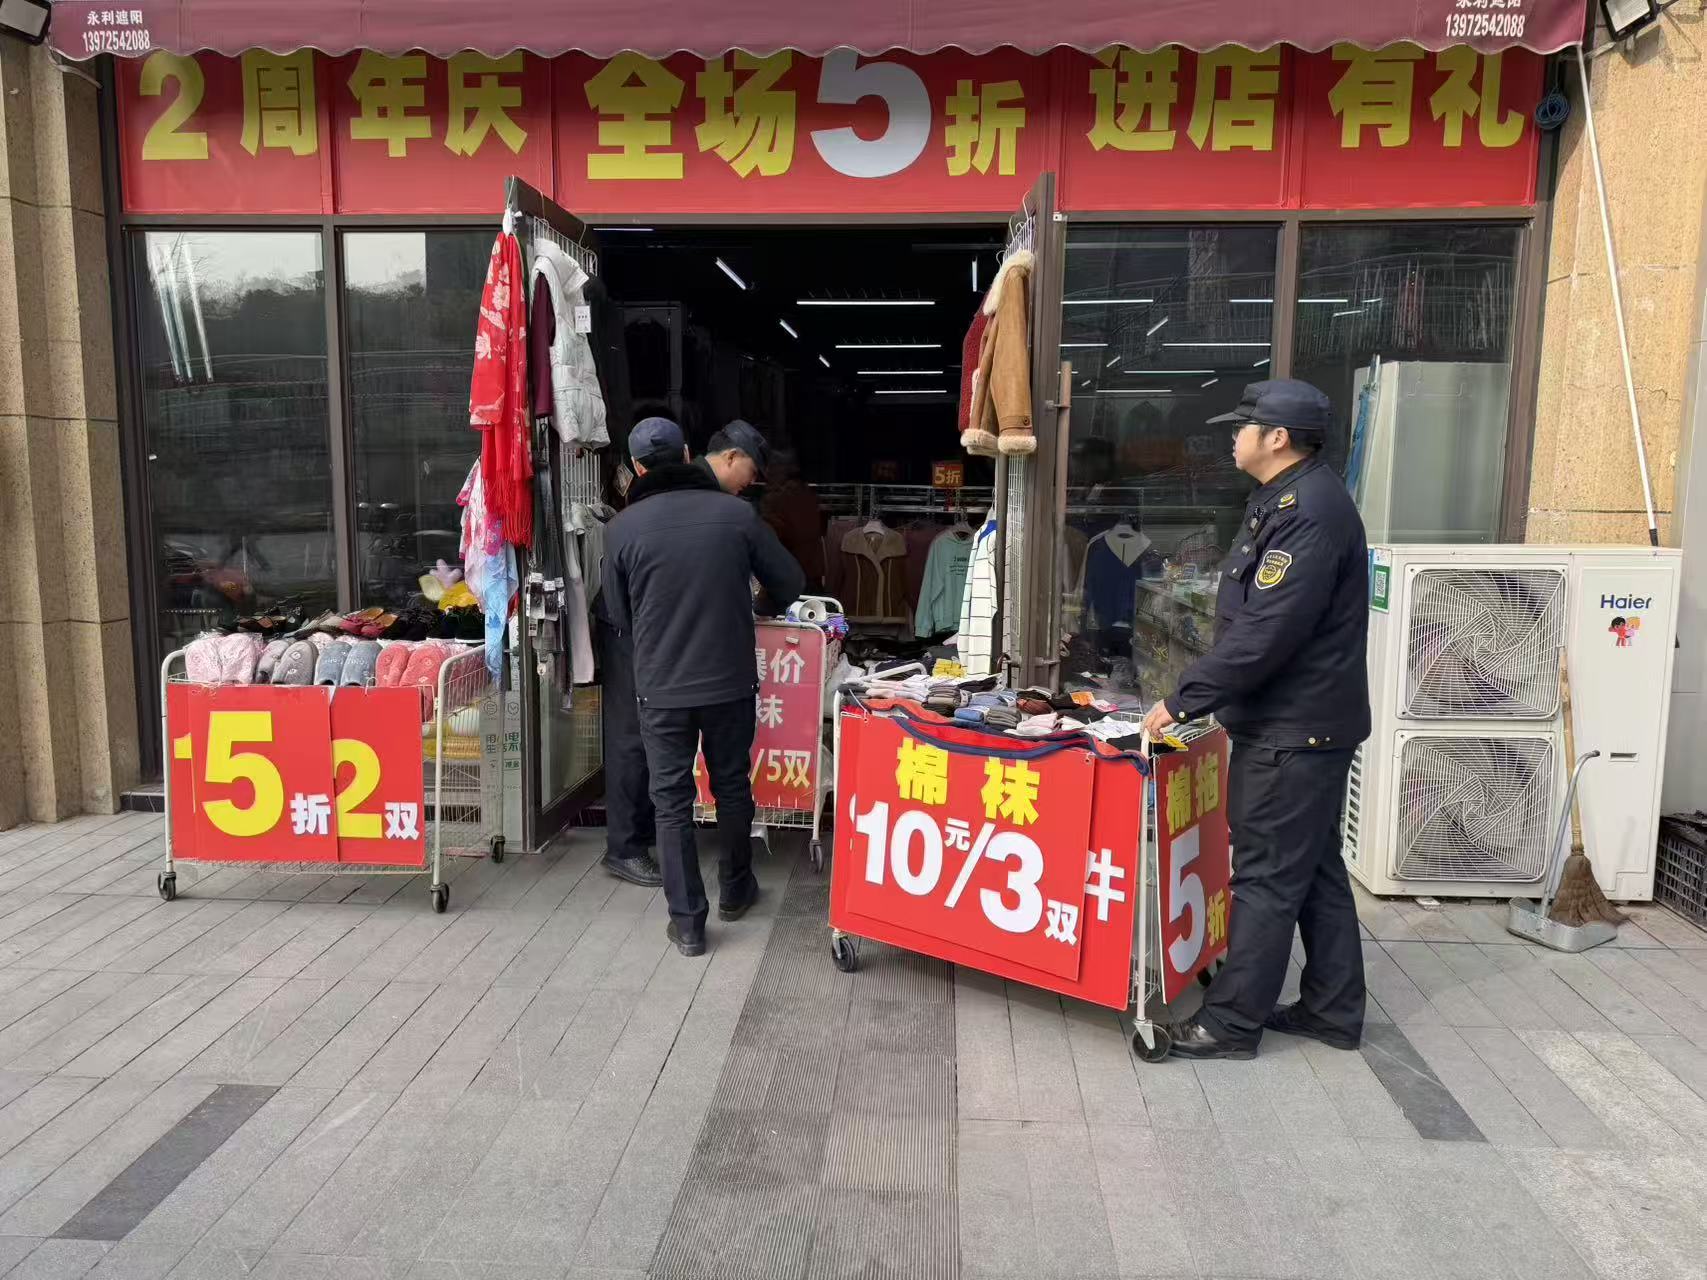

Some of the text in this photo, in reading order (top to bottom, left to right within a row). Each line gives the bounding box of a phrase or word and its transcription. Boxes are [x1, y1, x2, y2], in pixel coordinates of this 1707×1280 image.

[87, 10, 143, 26] 永利遮阳
[1446, 13, 1526, 37] 13972542088
[83, 29, 151, 52] 13972542088
[139, 42, 1525, 180] 2周年庆 全场5折 进店有礼
[934, 465, 961, 485] 5折
[1600, 594, 1652, 609] Haier
[202, 710, 331, 838] 5折
[856, 800, 1080, 947] 10元/3双
[1168, 822, 1226, 974] 5折
